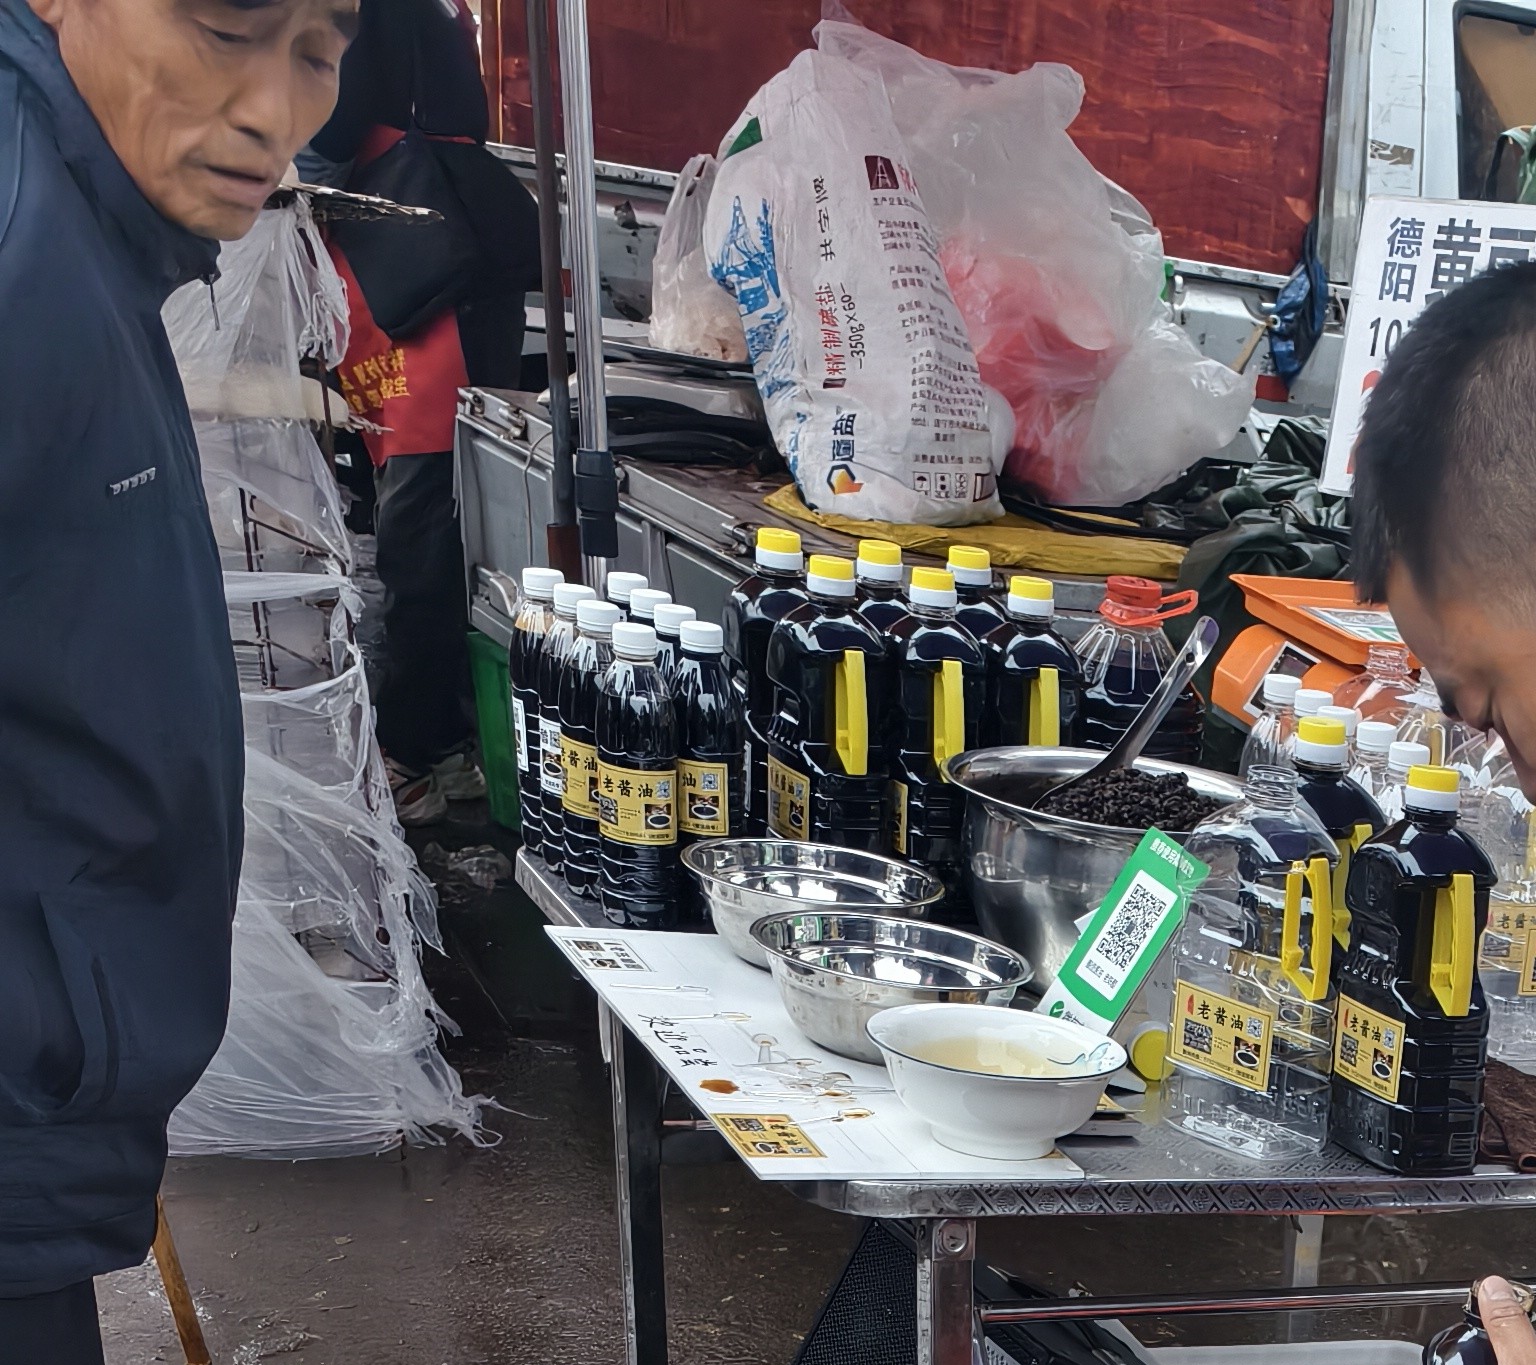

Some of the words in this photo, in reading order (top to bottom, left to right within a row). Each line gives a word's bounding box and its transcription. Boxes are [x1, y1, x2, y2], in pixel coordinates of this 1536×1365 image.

[1378, 216, 1425, 303] 德阳
[1368, 316, 1414, 358] 10
[603, 774, 654, 798] 老酱油
[1196, 999, 1244, 1032] 老酱油
[1348, 1012, 1382, 1043] 老酱油
